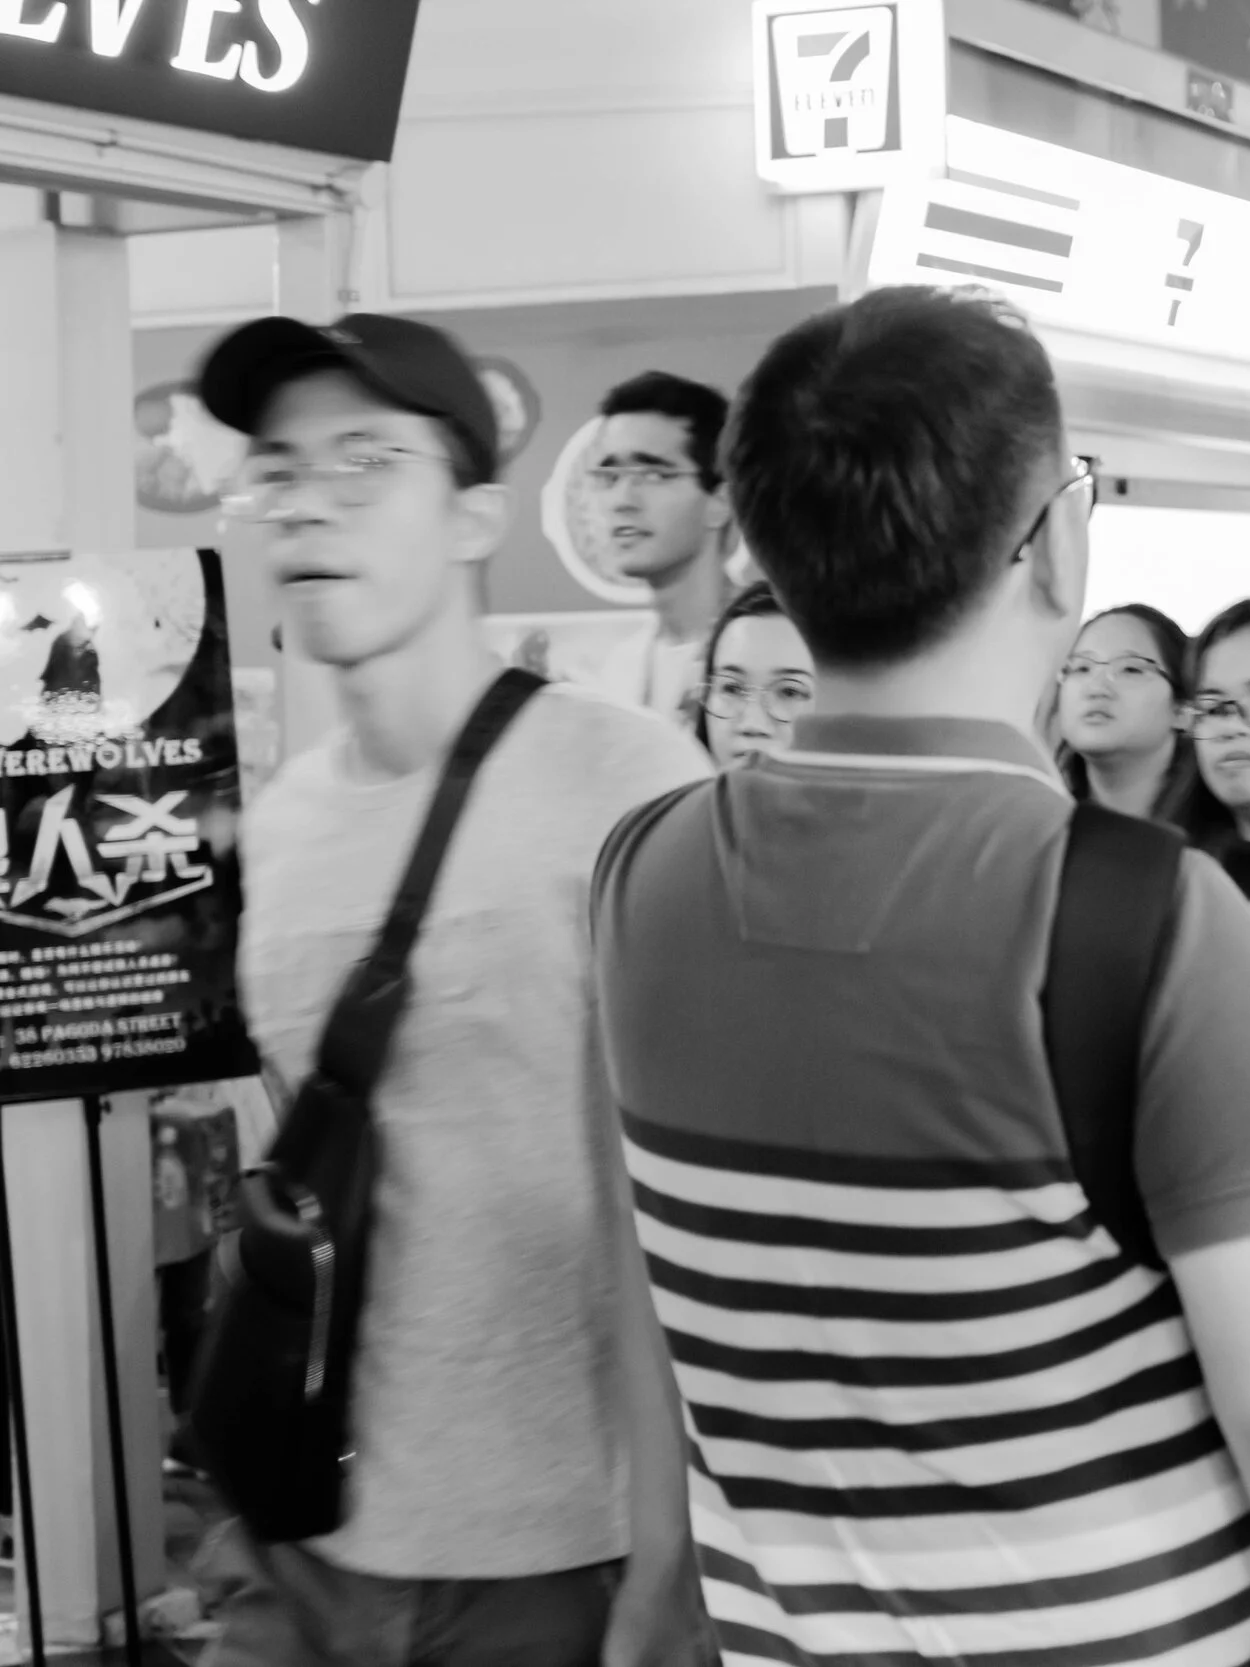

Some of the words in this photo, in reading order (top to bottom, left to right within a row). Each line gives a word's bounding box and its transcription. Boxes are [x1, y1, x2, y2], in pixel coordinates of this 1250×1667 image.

[796, 30, 870, 148] 7
[0, 738, 203, 777] EREWOLVES
[0, 784, 208, 906] 人杀
[117, 1013, 182, 1033] STREET
